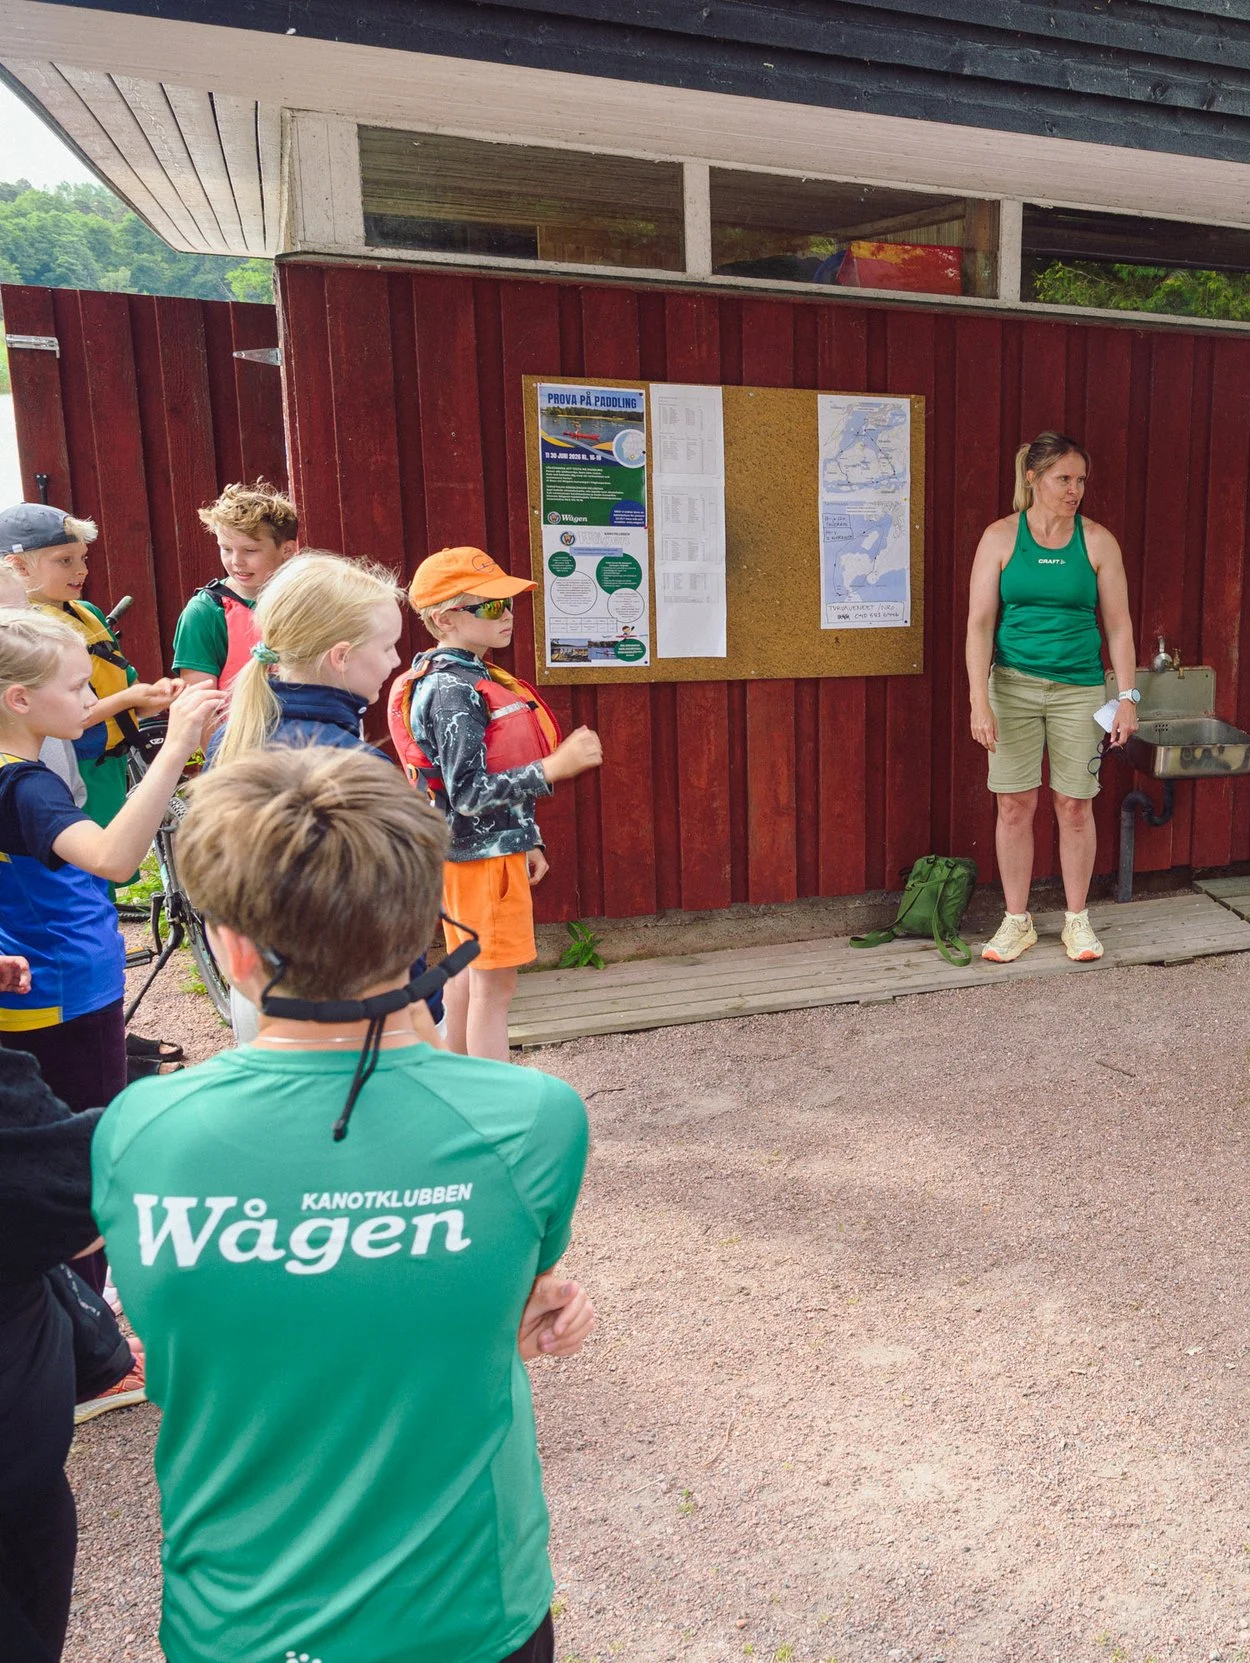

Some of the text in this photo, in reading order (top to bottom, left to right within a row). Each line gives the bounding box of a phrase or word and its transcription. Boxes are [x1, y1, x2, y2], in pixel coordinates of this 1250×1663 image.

[547, 391, 637, 409] PROVA PÅ PADDLING
[301, 1183, 473, 1212] KANOTKLUBBEN
[133, 1193, 473, 1276] Wågen
